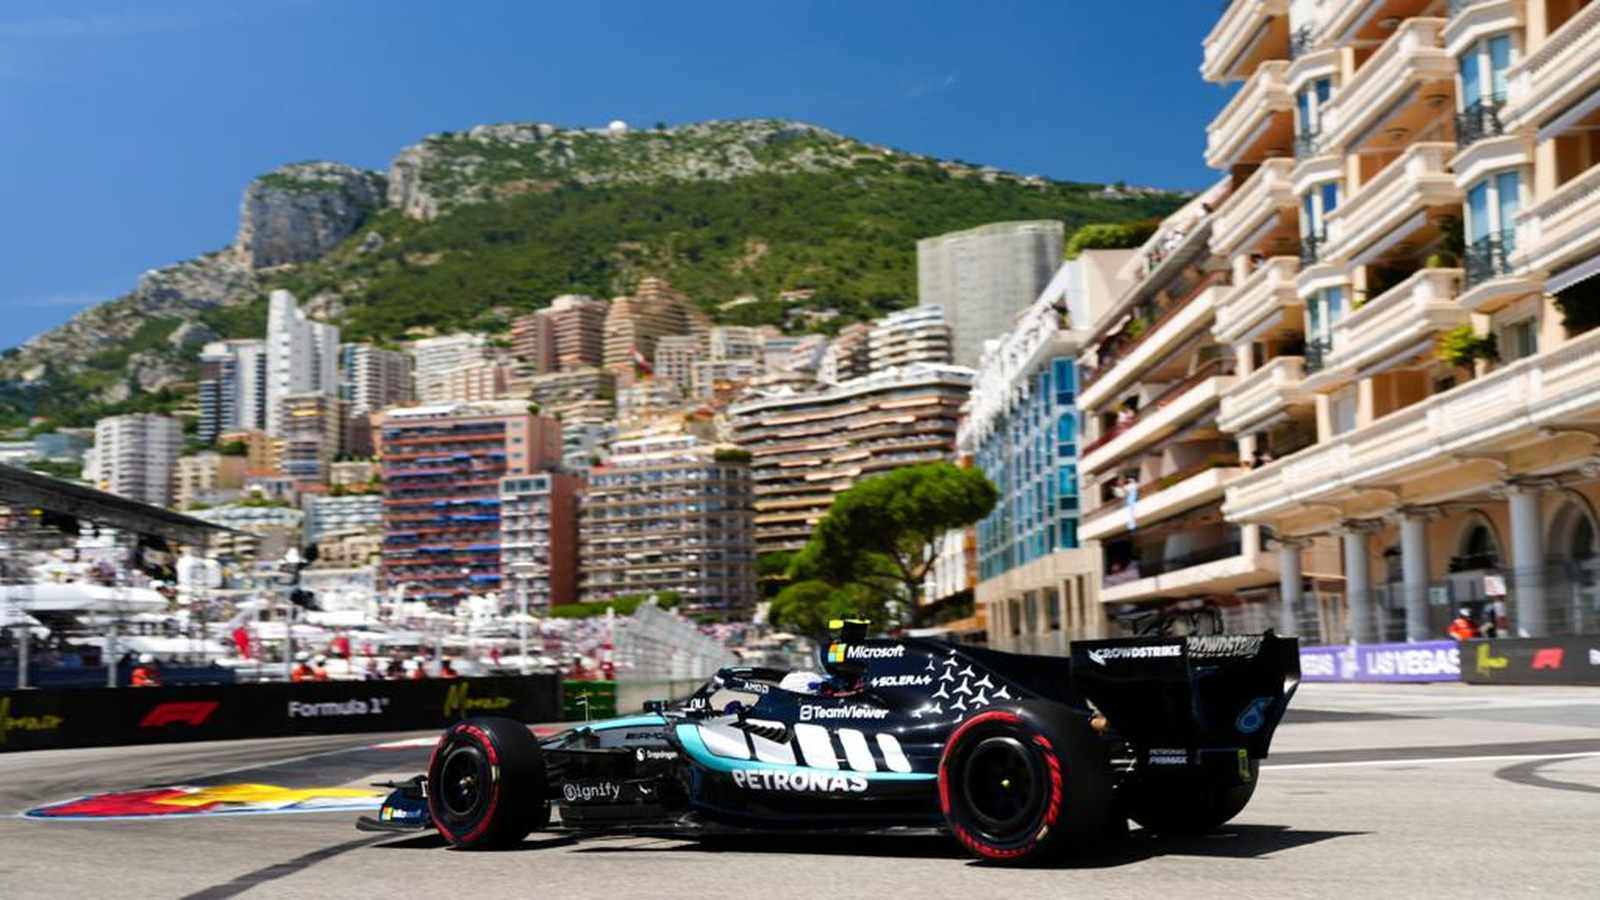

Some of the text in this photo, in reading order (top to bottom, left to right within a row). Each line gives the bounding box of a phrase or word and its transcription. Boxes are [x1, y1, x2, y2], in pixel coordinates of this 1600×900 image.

[847, 645, 905, 660] Microsoft
[1096, 645, 1182, 659] CROWDSTRIKE
[1396, 648, 1461, 675] VEGAS
[879, 675, 923, 687] SOLERA
[288, 699, 368, 717] Formula
[813, 704, 889, 720] TeamViewer
[732, 770, 868, 792] PETRONAS
